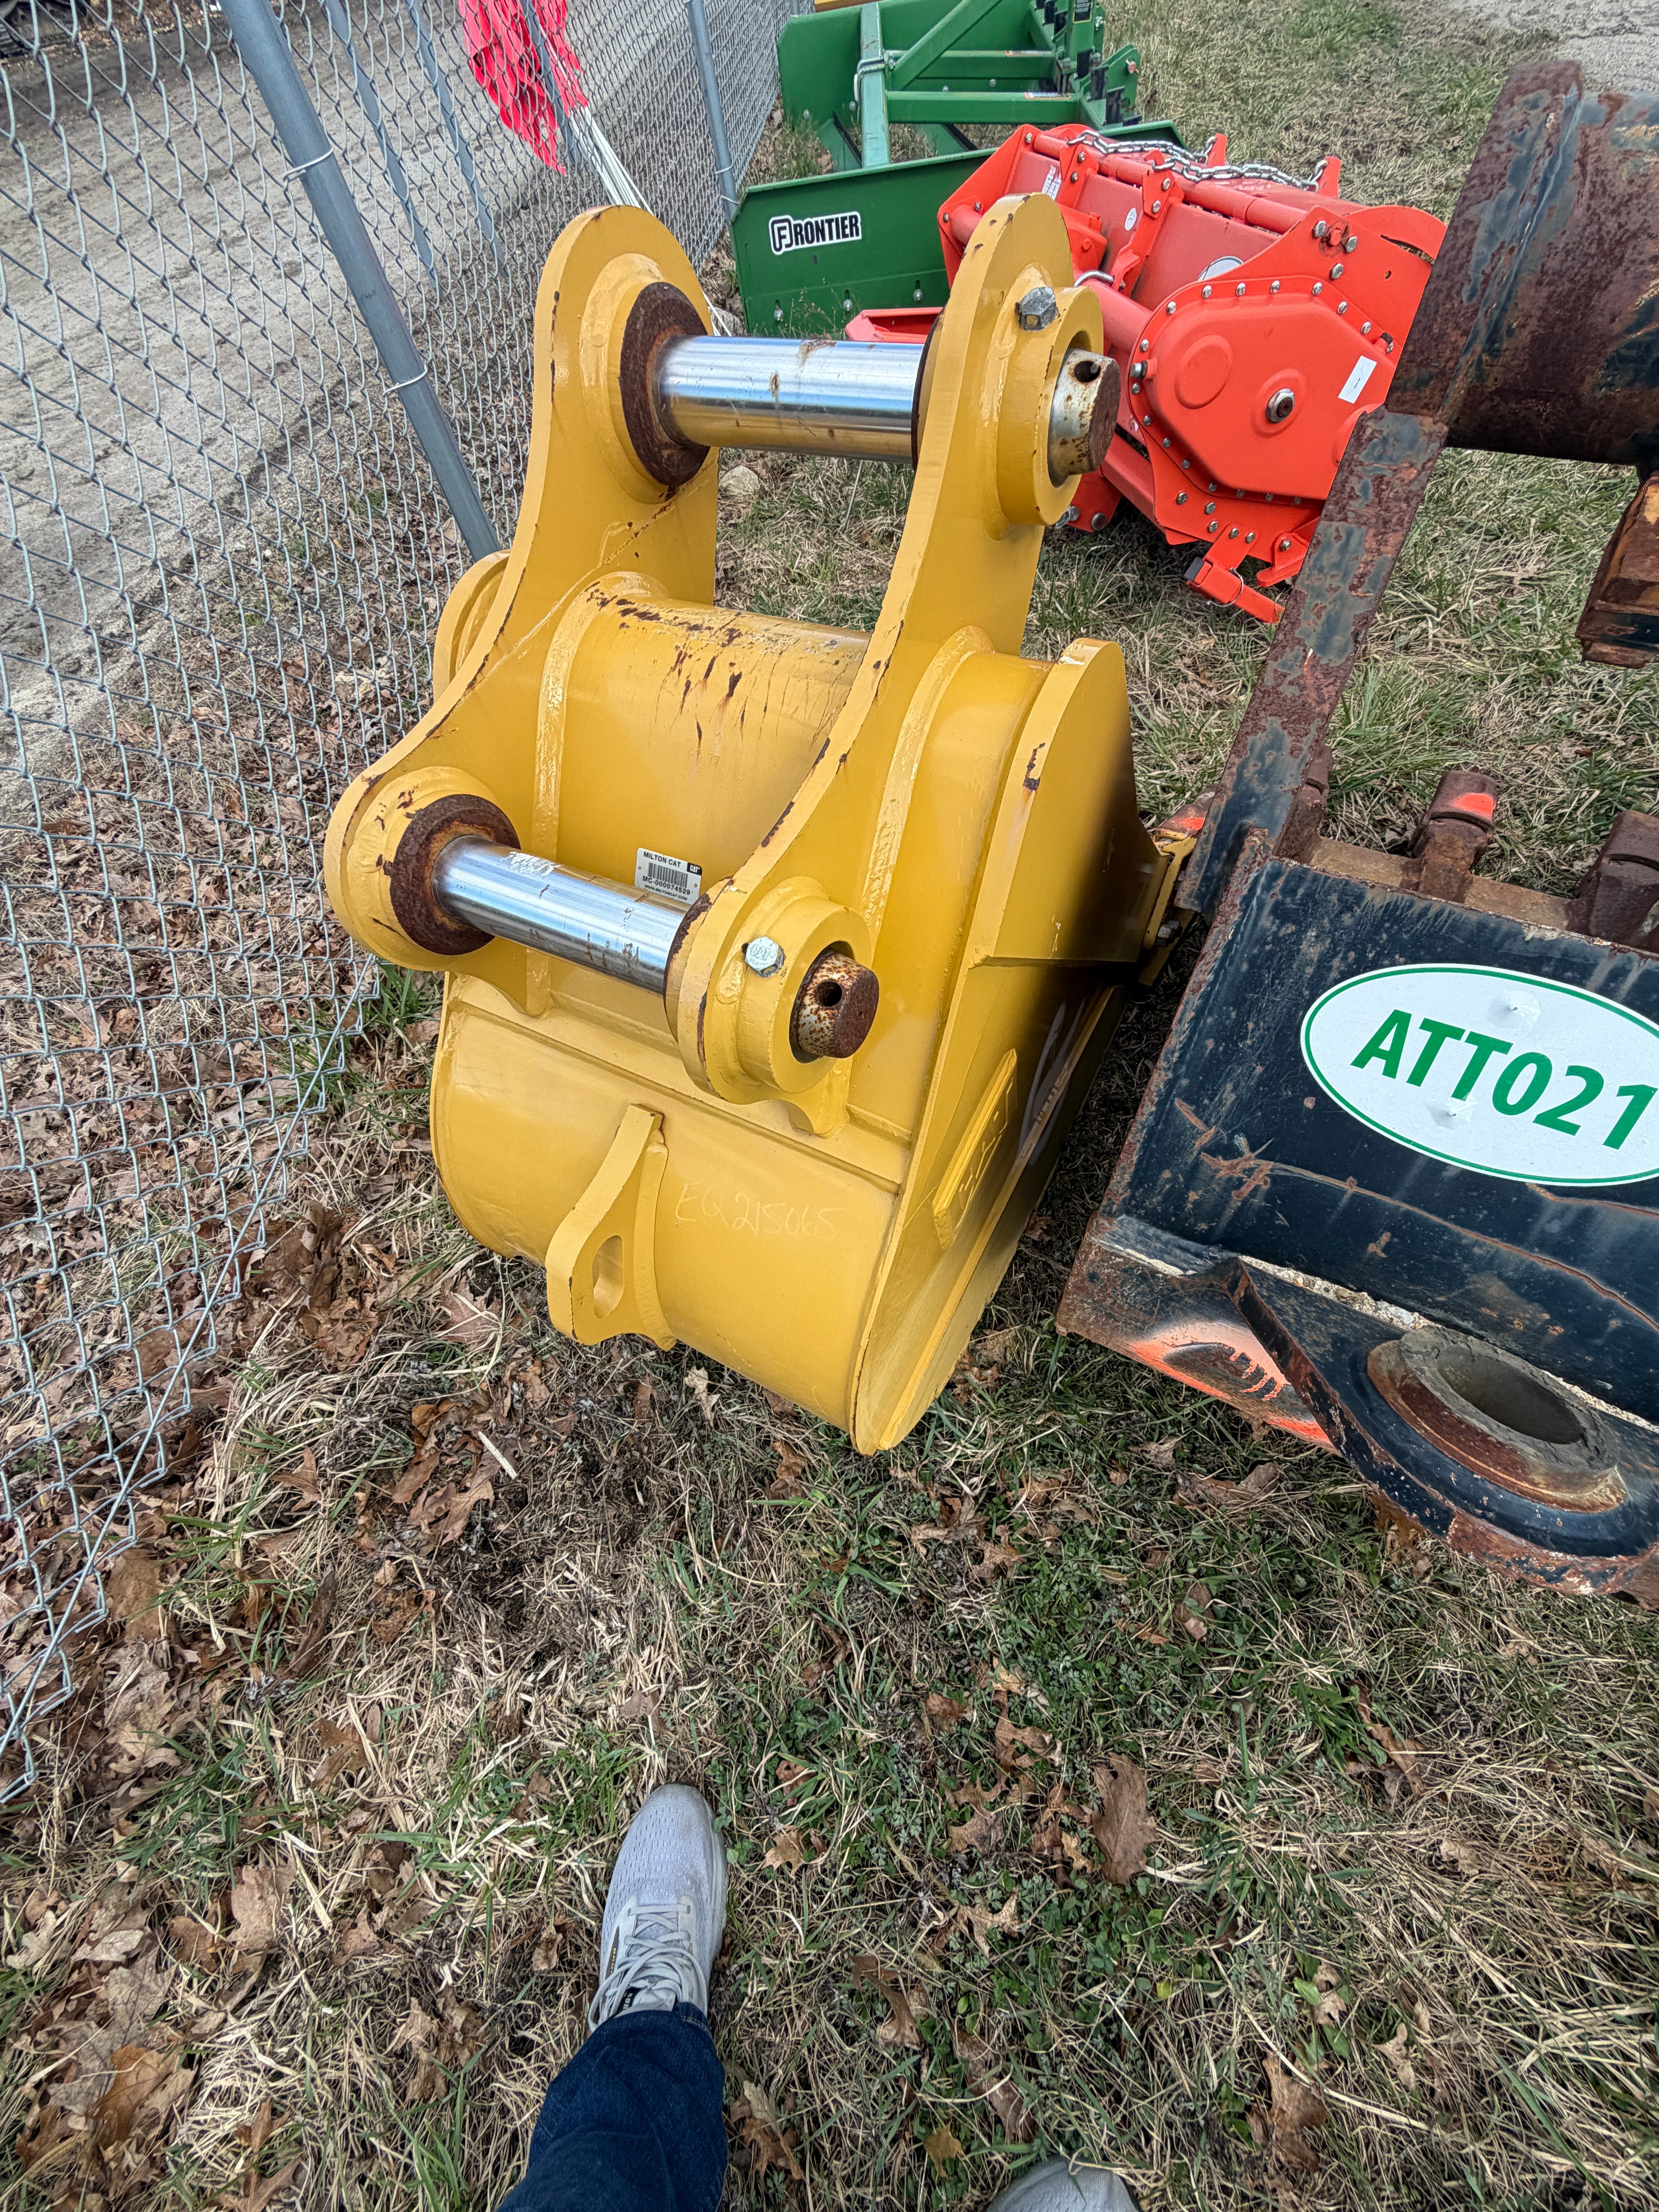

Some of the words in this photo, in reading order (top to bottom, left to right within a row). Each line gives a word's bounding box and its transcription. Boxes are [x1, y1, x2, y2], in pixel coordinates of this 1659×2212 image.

[771, 215, 859, 252] FRONTIER
[643, 851, 666, 863] MILTON
[668, 859, 681, 868] CAT
[690, 864, 698, 873] CAT
[642, 875, 690, 895] MC-000074529
[1350, 1009, 1658, 1150] ATT021
